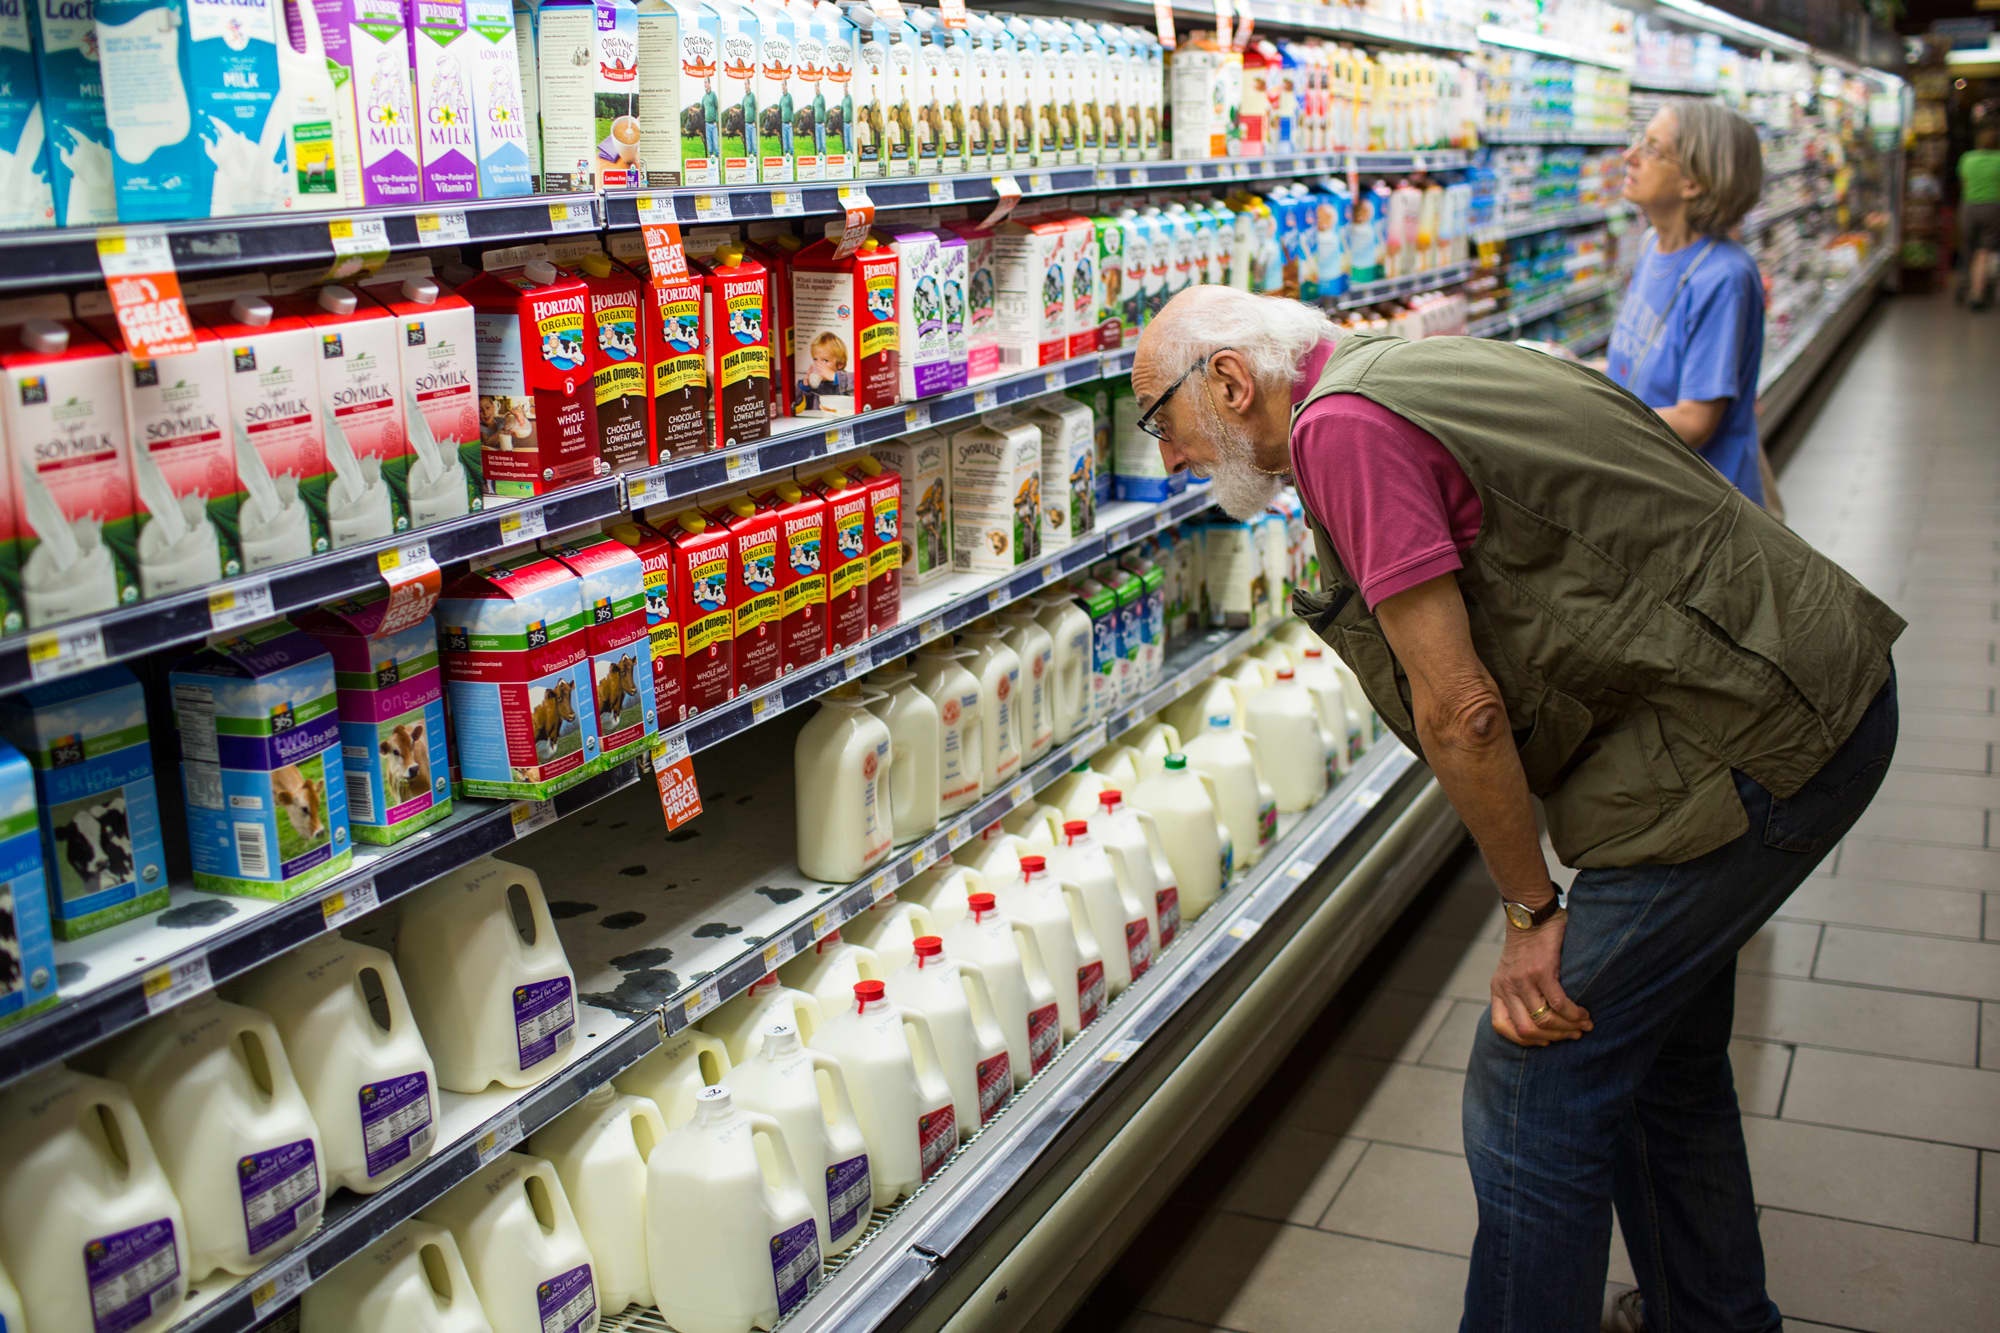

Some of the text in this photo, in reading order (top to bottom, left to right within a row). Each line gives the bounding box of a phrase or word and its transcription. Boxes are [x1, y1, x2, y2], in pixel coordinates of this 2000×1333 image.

[601, 36, 634, 51] ORGANIC
[683, 36, 714, 49] ORGANIC
[725, 38, 754, 51] ORGANIC
[764, 40, 791, 52] ORGANIC
[605, 47, 630, 60] VALLEY
[687, 45, 711, 58] VALLEY
[728, 47, 750, 60] VALLEY
[222, 71, 259, 88] MILK
[370, 128, 413, 145] MILK
[430, 128, 471, 145] MILK
[490, 126, 523, 139] MILK
[377, 183, 417, 195] Vitamin D
[436, 181, 472, 193] Vitamin D
[648, 244, 681, 263] GREAT
[652, 256, 687, 277] PRICE!
[863, 262, 897, 280] HORIZON
[723, 279, 765, 301] HORIZON
[867, 277, 895, 290] ORGANIC
[591, 290, 637, 312] HORIZON
[657, 284, 701, 306] HORIZON
[730, 296, 761, 310] ORGANIC
[118, 297, 179, 326] GREAT
[532, 295, 584, 322] HORIZON
[598, 310, 635, 323] ORGANIC
[663, 304, 698, 317] ORGANIC
[125, 316, 191, 347] PRICE!
[541, 316, 582, 332] ORGANIC
[724, 347, 768, 368] DHA Omega-3
[594, 364, 644, 387] DHA Omega-3
[658, 355, 706, 379] DHA Omega-3
[415, 370, 469, 391] SOYMILK
[566, 382, 574, 394] D
[333, 383, 391, 406] SOYMILK
[245, 398, 311, 423] SOYMILK
[562, 403, 579, 412] organic
[733, 400, 764, 414] CHOCOLATE
[557, 411, 585, 425] WHOLE
[668, 411, 701, 424] CHOCOLATE
[733, 410, 753, 423] LOWFAT
[145, 414, 220, 440] SOYMILK
[563, 424, 582, 437] MILK
[606, 421, 641, 435] CHOCOLATE
[668, 419, 703, 433] LOWFAT MILK
[606, 430, 643, 445] LOWFAT MILK
[34, 434, 115, 459] SOYMILK
[871, 484, 900, 507] HORIZON
[834, 497, 865, 521] HORIZON
[785, 512, 823, 536] HORIZON
[838, 514, 864, 529] ORGANIC
[738, 526, 778, 551] HORIZON
[790, 528, 820, 544] ORGANIC
[407, 546, 426, 560] $4.99
[688, 543, 729, 567] HORIZON
[744, 545, 774, 562] ORGANIC
[642, 552, 668, 572] RIZON
[693, 562, 726, 579] ORGANIC
[643, 573, 666, 587] GANIC
[833, 571, 846, 585] DHA
[784, 577, 825, 601] DHA Omega-3
[595, 601, 633, 622] 365 organic
[737, 595, 780, 622] DHA Omega-3
[528, 623, 571, 646] 365 organic
[686, 613, 732, 640] DHA Omega-3
[608, 627, 648, 649] Vitamin D Milk
[747, 646, 765, 659] WHOLE
[543, 650, 586, 673] Vitamin D Milk
[657, 661, 663, 671] D
[379, 670, 397, 683] 365
[696, 664, 728, 680] WHOLE MILK
[382, 691, 411, 712] one
[273, 716, 294, 732] 365
[663, 775, 693, 806] GREAT
[666, 786, 699, 820] PRICE!
